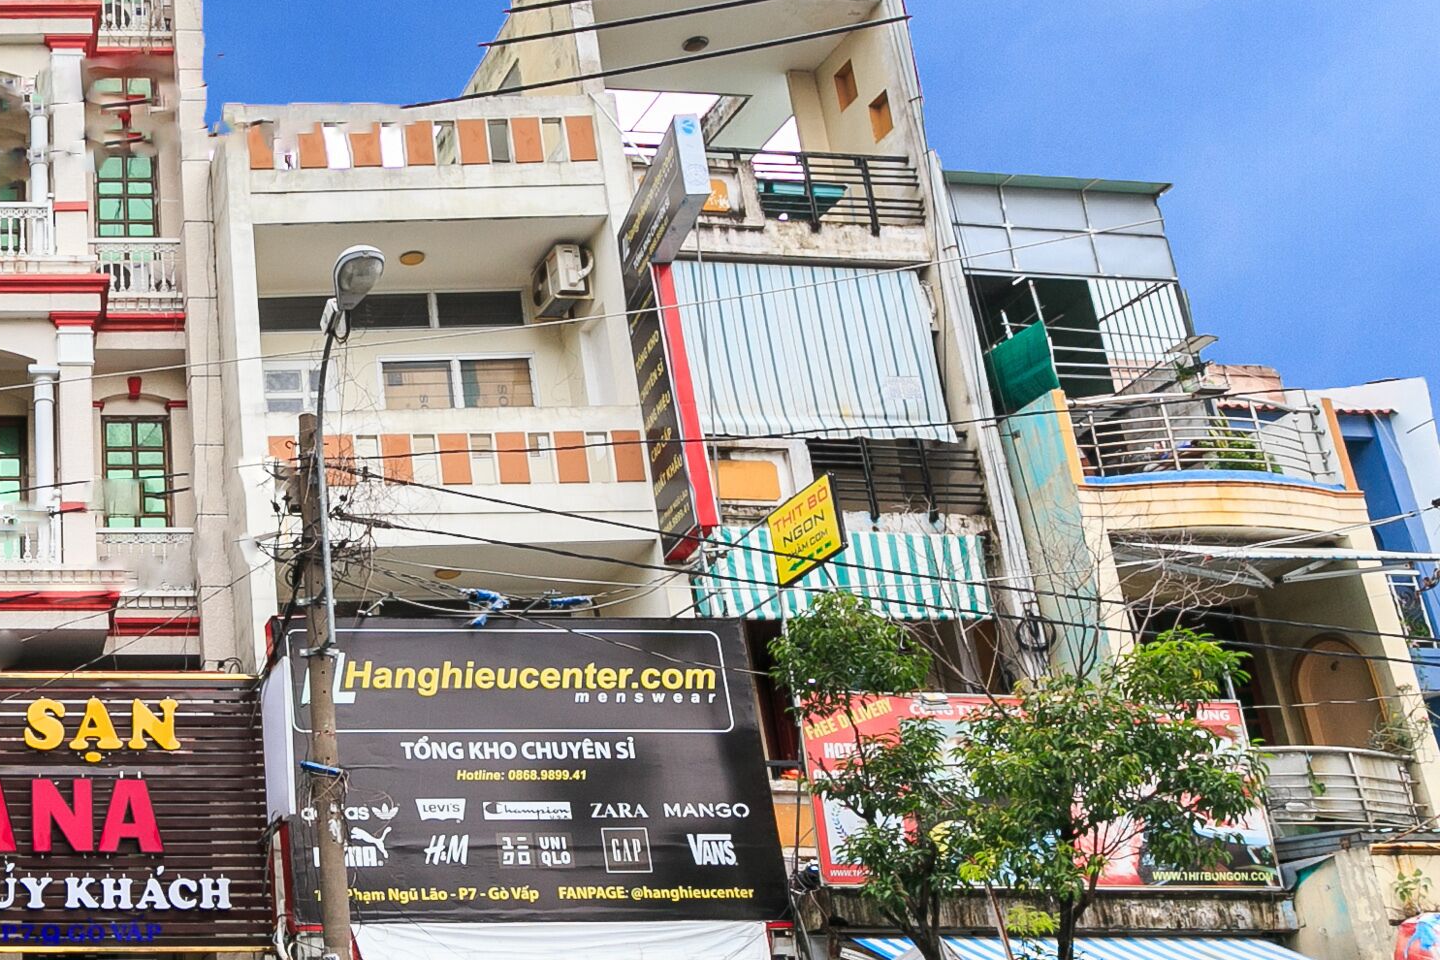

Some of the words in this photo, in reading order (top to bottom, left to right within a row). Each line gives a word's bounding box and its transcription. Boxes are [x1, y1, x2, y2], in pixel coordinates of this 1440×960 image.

[773, 501, 804, 532] THỊT
[807, 485, 828, 510] BÒ
[783, 509, 825, 548] NGON
[344, 660, 716, 697] Hanghieucenter.com
[574, 691, 716, 703] menswear
[24, 696, 181, 762] SẠN
[805, 716, 838, 740] FREE
[400, 736, 464, 760] TỔNG
[469, 742, 516, 760] KHO
[521, 738, 611, 760] CHUYÊN
[616, 737, 636, 759] SỈ
[457, 770, 505, 781] Hotline:
[508, 769, 587, 781] 0868.9899.41
[485, 802, 570, 820] Champion
[590, 803, 649, 818] ZARA
[663, 802, 750, 818] MANGO
[424, 834, 469, 865] H&M
[539, 836, 567, 850] UNI
[611, 838, 643, 862] GAP
[686, 834, 736, 865] VANS
[541, 851, 571, 867] QLO
[65, 864, 232, 910] KHÁCH
[388, 887, 419, 904] Ngũ
[421, 887, 448, 901] Lão
[459, 888, 477, 901] P7
[488, 887, 509, 901] Gò
[511, 885, 539, 903] Vấp
[558, 886, 629, 899] FANPAGE:
[631, 886, 754, 902] @hanghieucenter
